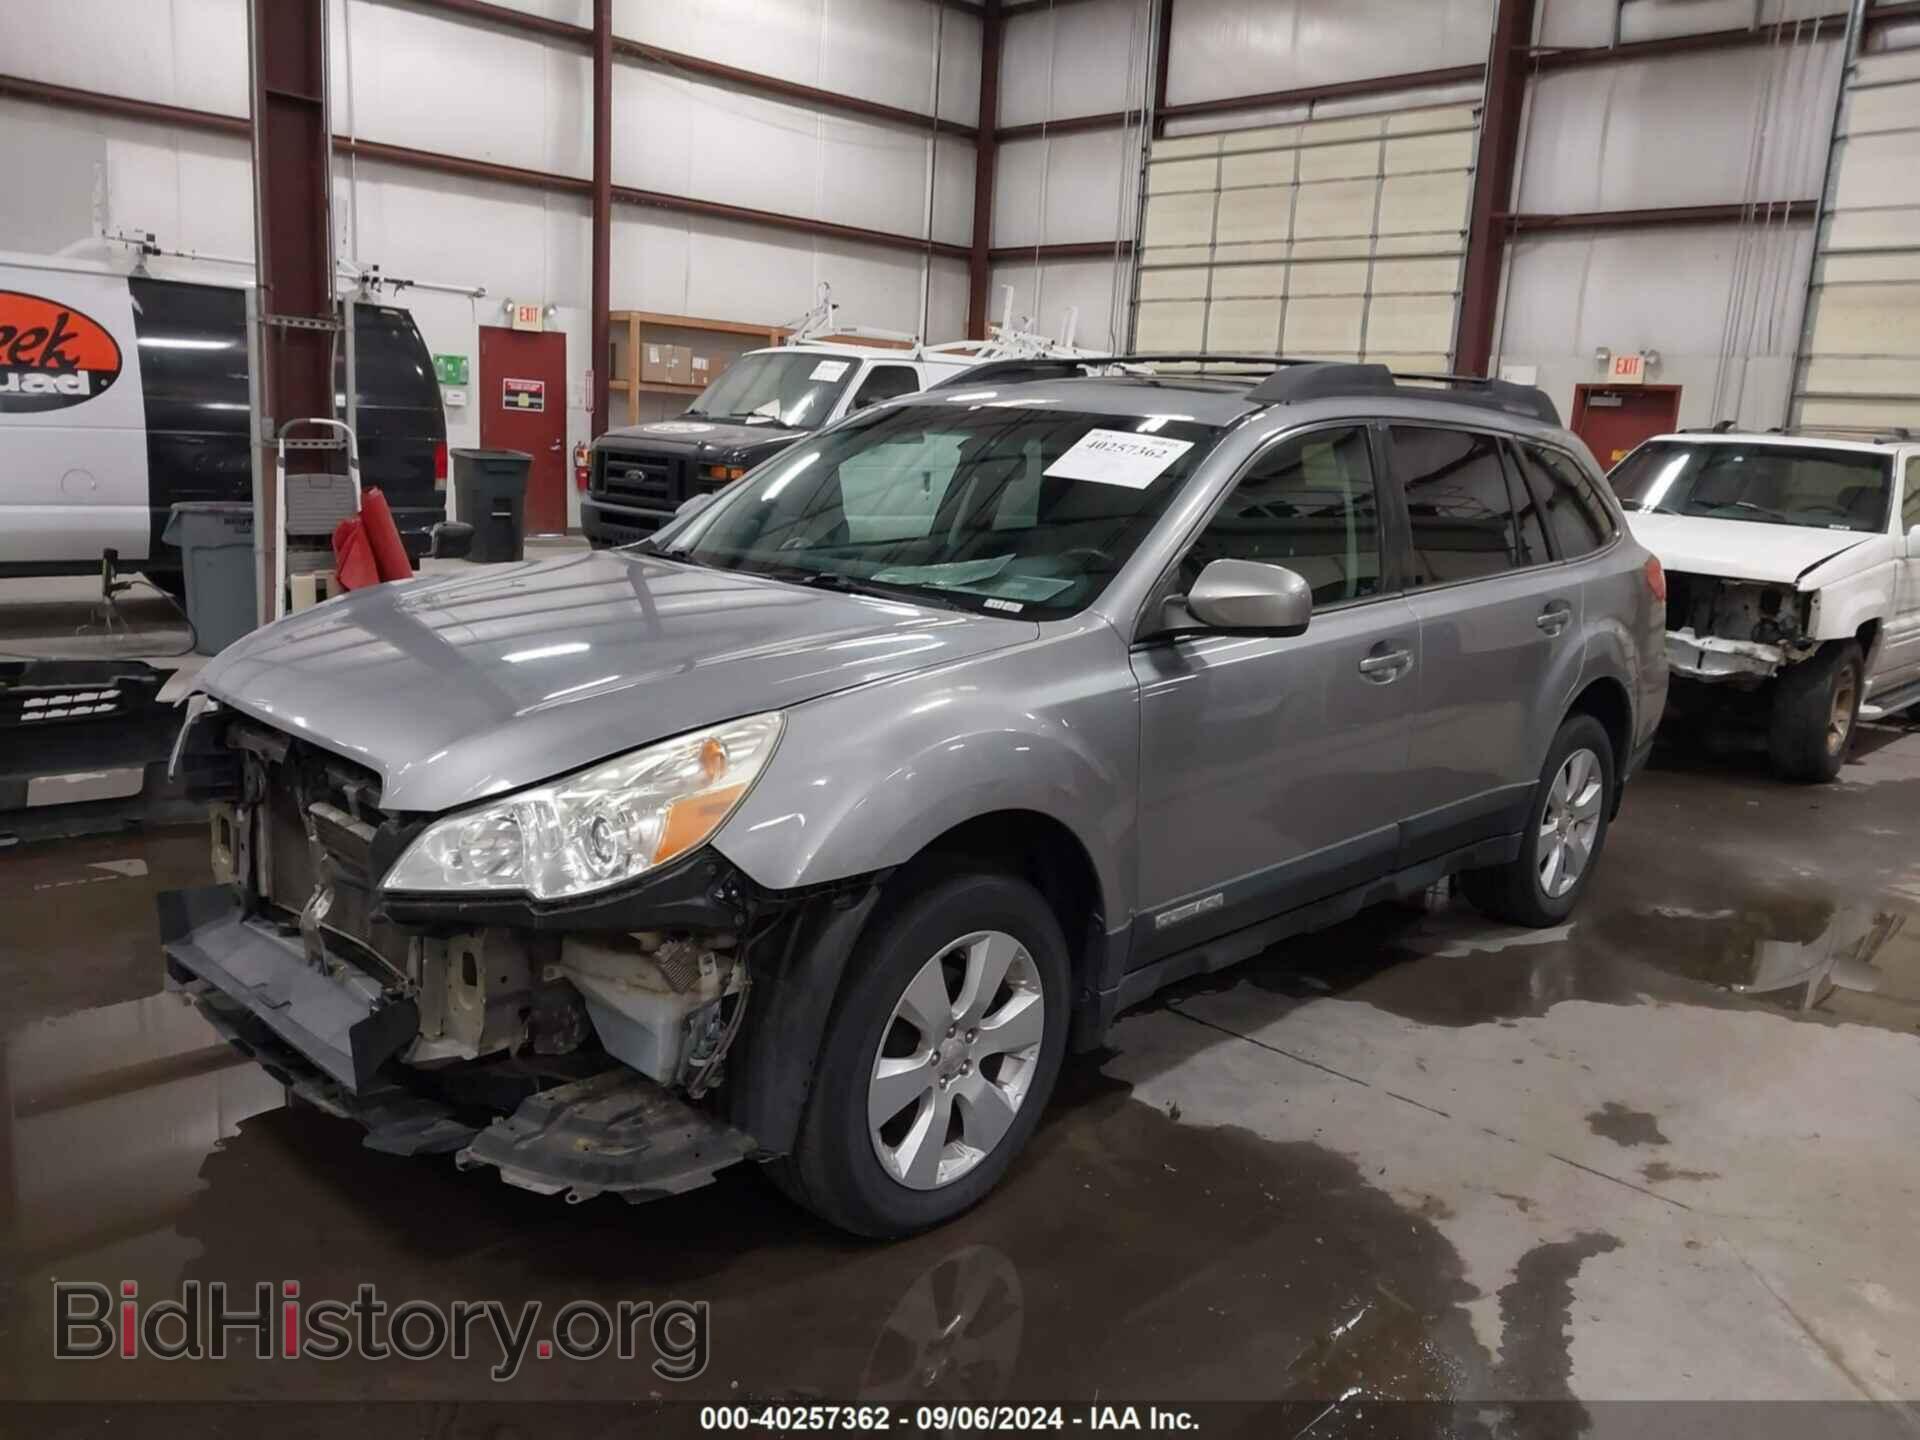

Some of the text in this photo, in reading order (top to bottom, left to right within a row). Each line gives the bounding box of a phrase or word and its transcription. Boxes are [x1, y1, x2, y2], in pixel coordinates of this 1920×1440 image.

[519, 305, 538, 322] EXIT
[1615, 357, 1640, 374] EXIT
[1086, 440, 1168, 459] 40257362
